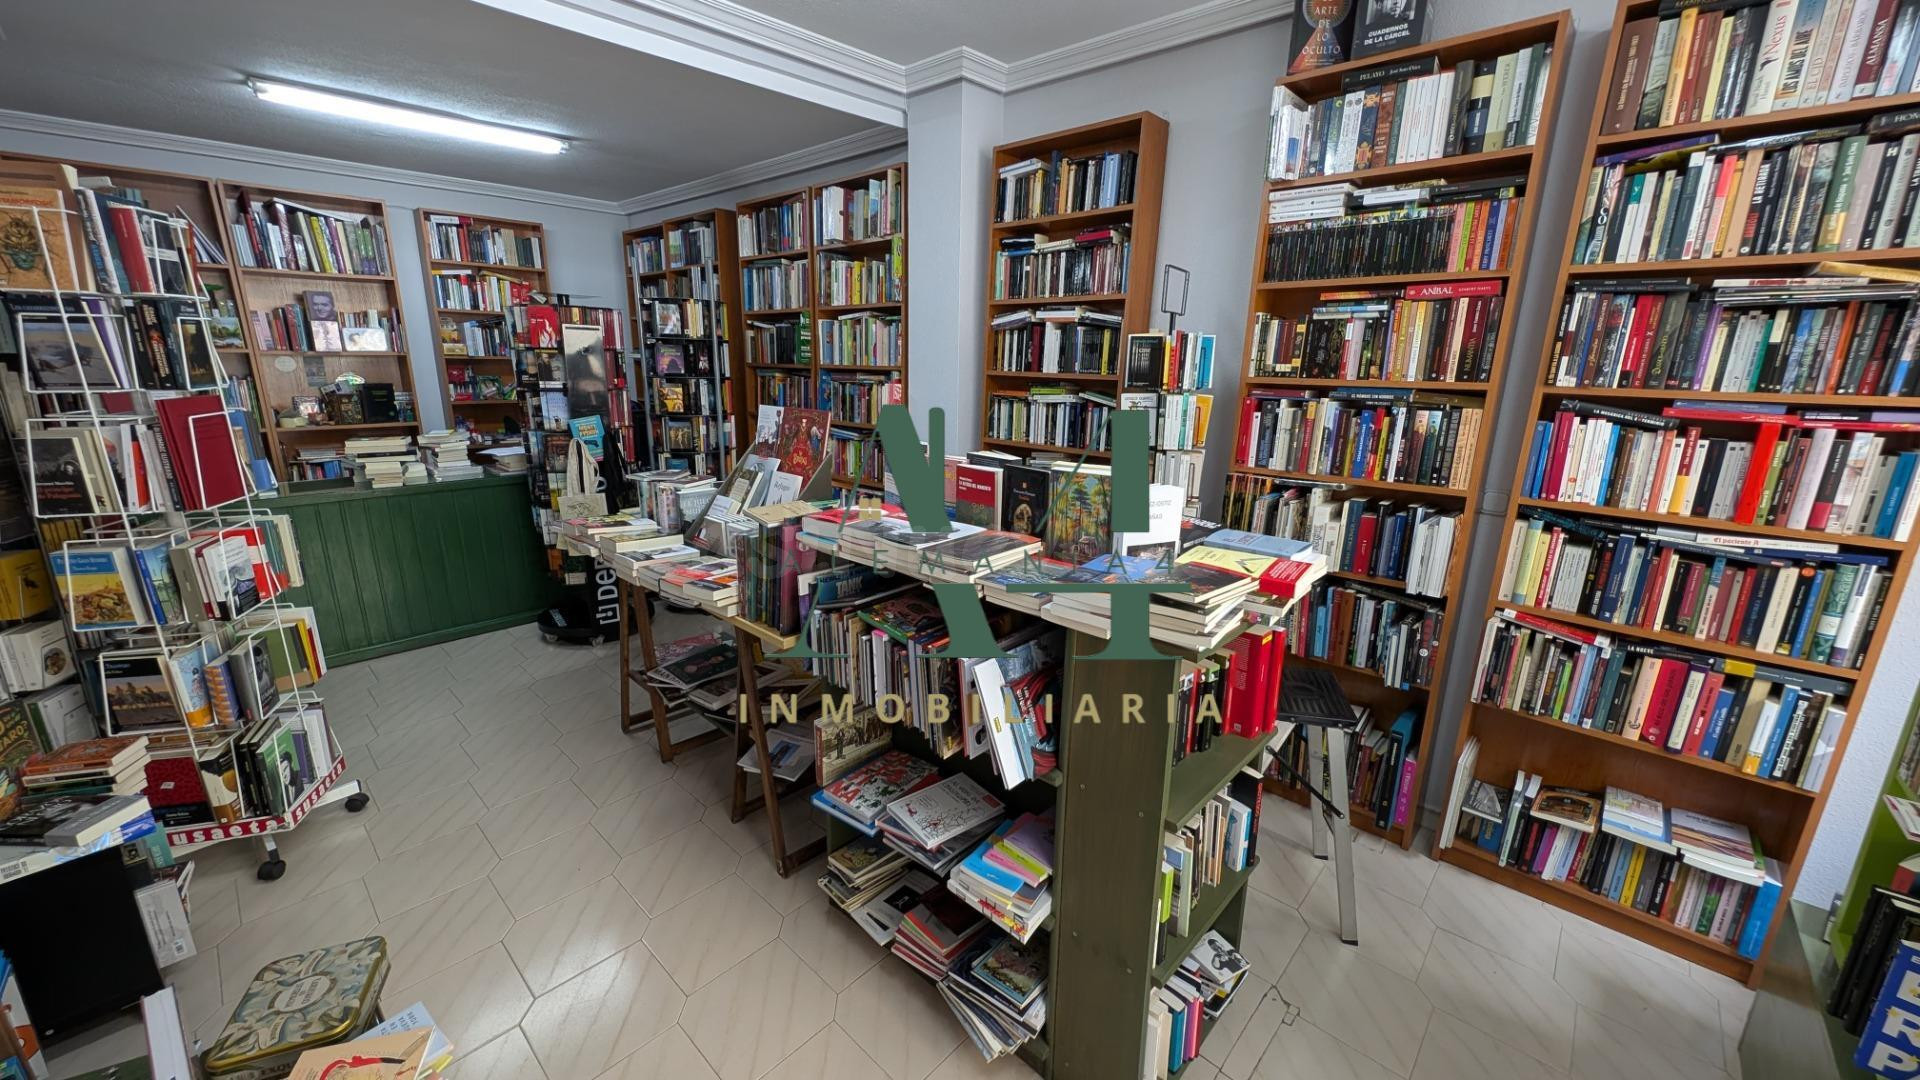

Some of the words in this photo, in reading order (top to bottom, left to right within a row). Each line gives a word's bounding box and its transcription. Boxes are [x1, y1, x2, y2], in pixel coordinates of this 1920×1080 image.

[1314, 6, 1338, 15] ARTE
[1318, 20, 1330, 28] DE
[1368, 23, 1408, 38] CUADERNOS
[1762, 15, 1787, 56] Nexus
[1317, 33, 1329, 42] LO
[1364, 38, 1374, 46] DE
[1866, 18, 1889, 65] ALMANSA
[1302, 45, 1341, 55] OCULTO
[1420, 286, 1453, 296] ANÍBAL
[1722, 538, 1752, 547] paciente
[836, 576, 863, 597] TANK
[295, 762, 345, 821] susaeta
[172, 819, 279, 847] usaeta
